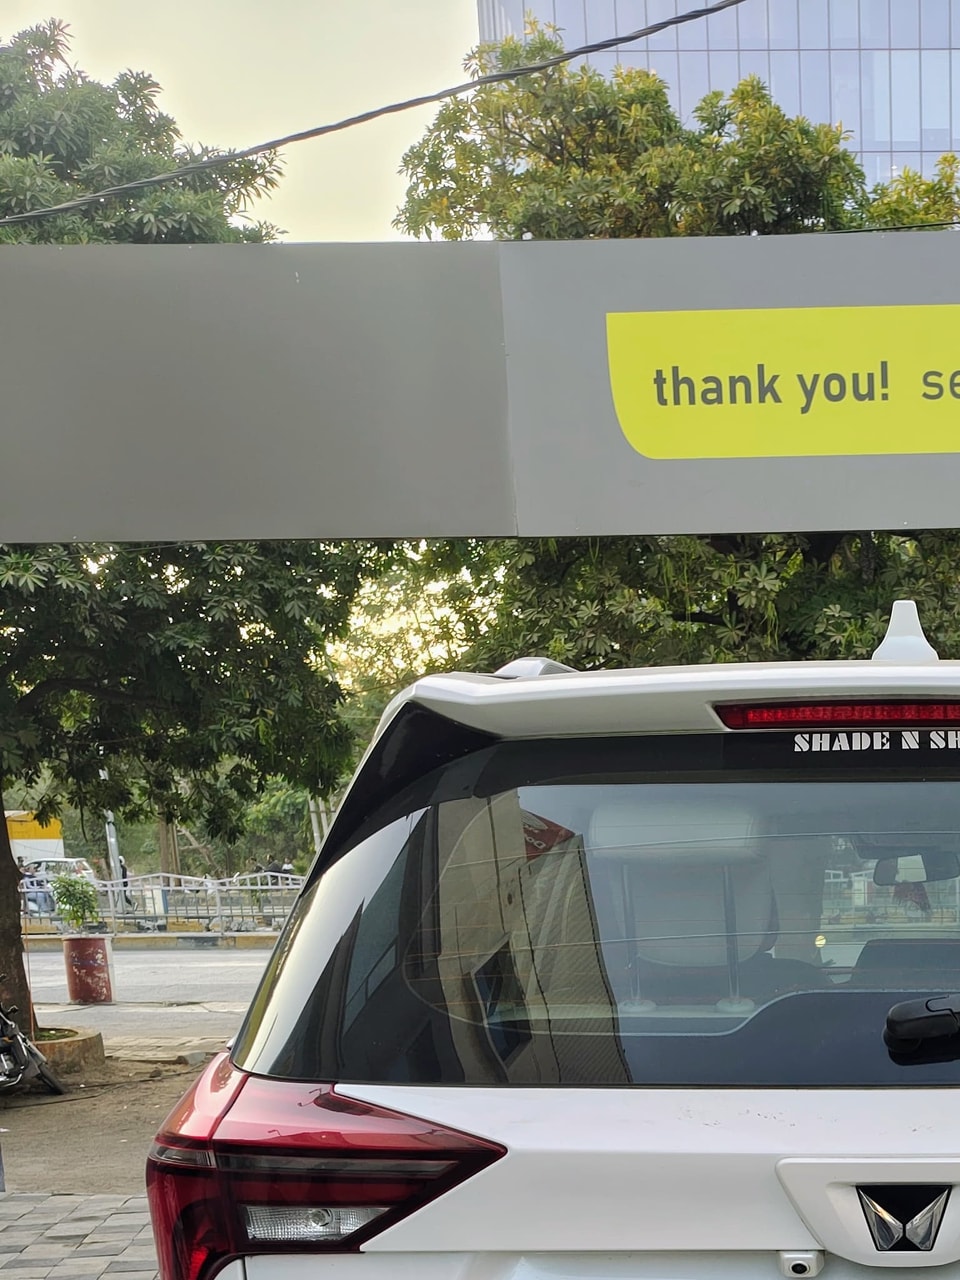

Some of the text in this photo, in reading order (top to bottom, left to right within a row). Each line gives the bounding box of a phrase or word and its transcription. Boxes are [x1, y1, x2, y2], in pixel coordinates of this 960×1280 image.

[653, 363, 783, 407] thank
[796, 360, 890, 415] you!
[793, 732, 891, 752] SHADE
[900, 731, 920, 749] N
